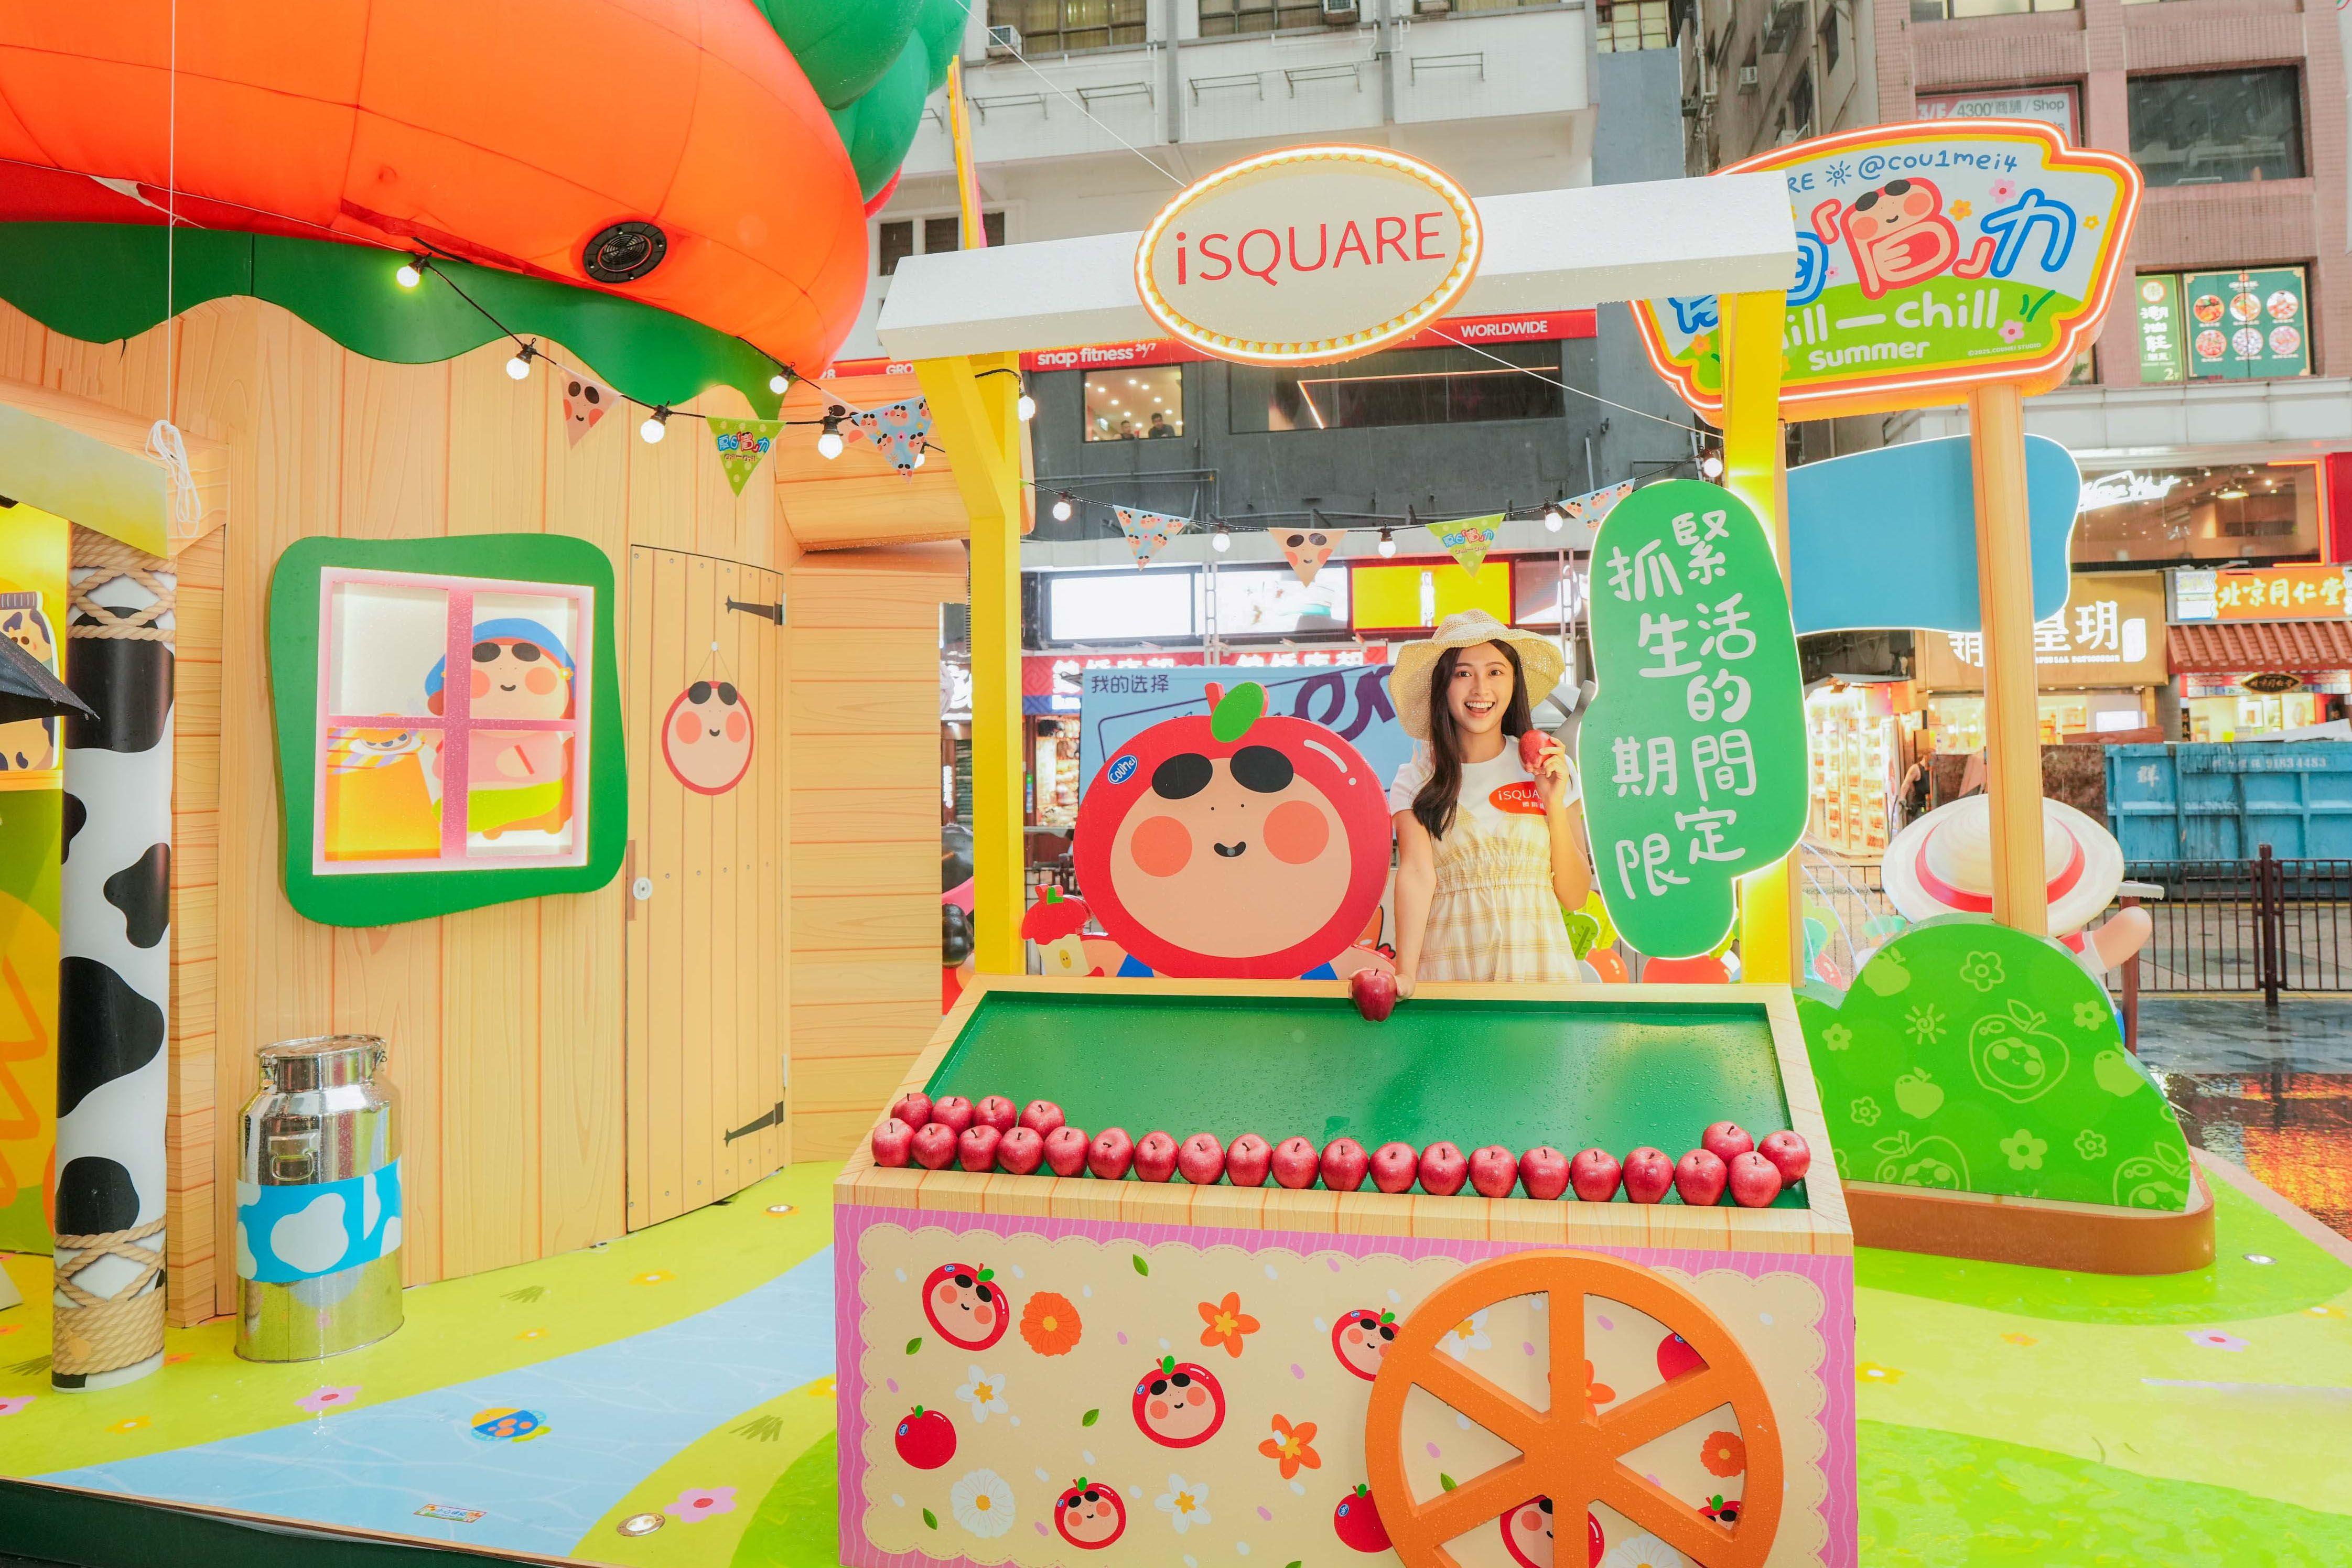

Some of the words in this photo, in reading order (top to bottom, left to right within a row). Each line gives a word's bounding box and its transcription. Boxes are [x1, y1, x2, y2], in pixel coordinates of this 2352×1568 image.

[2033, 99, 2065, 112] Shop
[1858, 150, 2017, 180] @cou1mei4
[1176, 211, 1446, 287] iSQUARE
[1037, 351, 1078, 367] snap
[1079, 346, 1135, 363] fitness
[1135, 342, 1157, 358] 24/7
[1460, 320, 1548, 338] WORLDWIDE
[1606, 510, 1730, 602] 抓緊
[1637, 592, 1757, 678] 生活
[1091, 674, 1169, 694] 我的选择
[1686, 668, 1752, 723] 的
[1611, 729, 1757, 802] 期間
[1615, 806, 1746, 900] 限定
